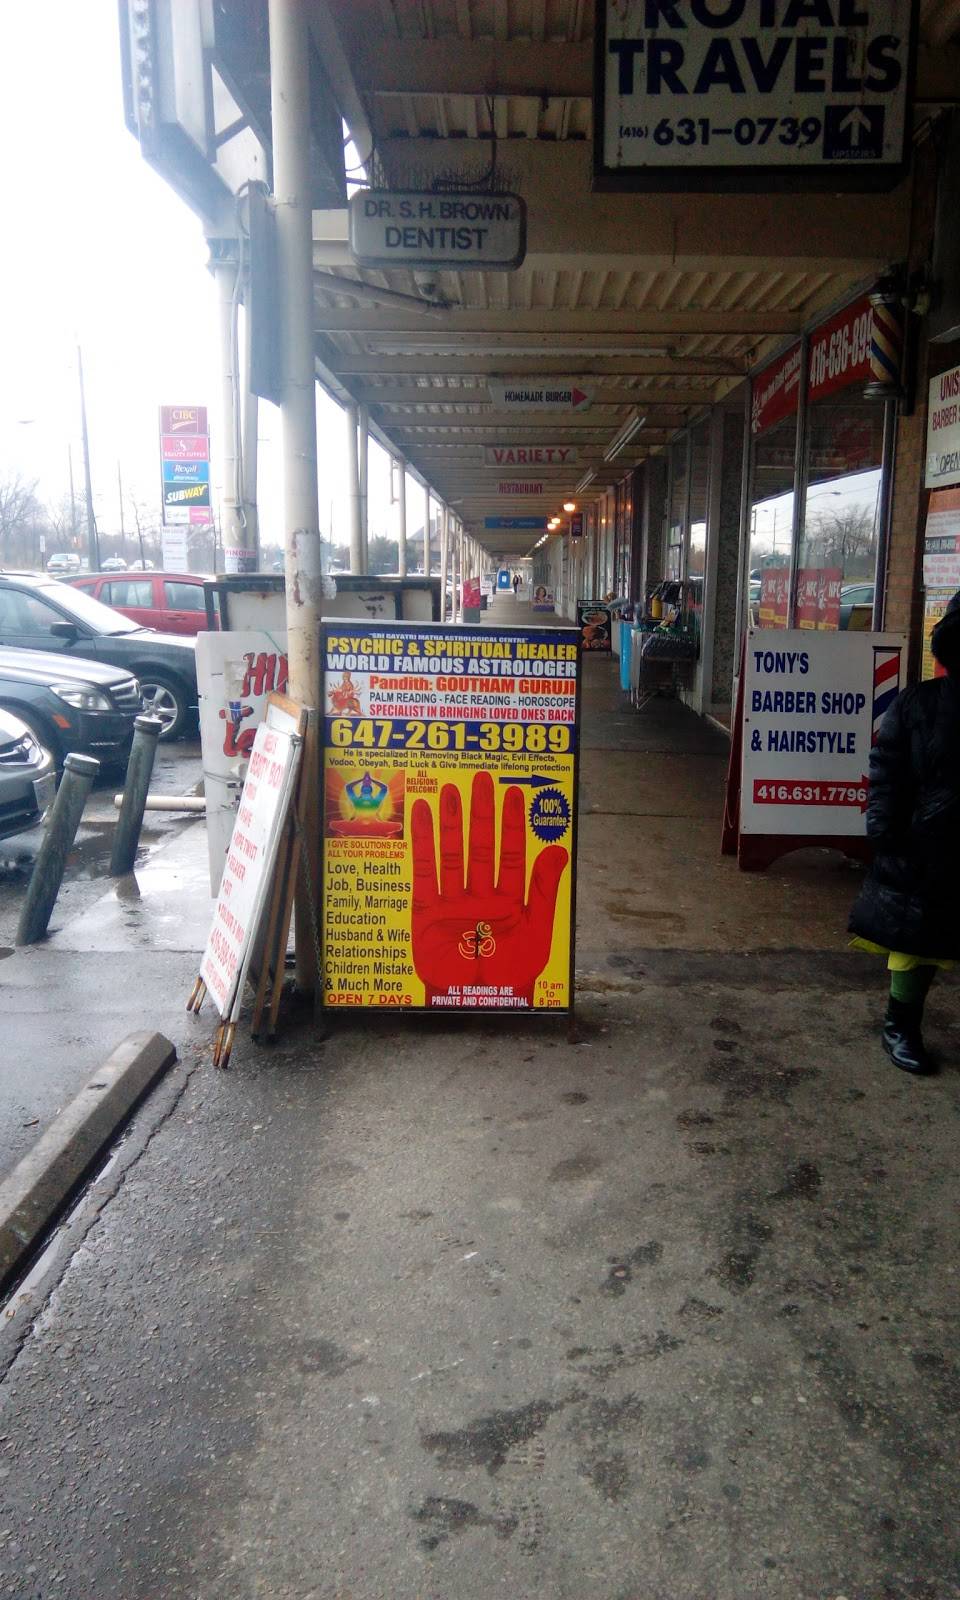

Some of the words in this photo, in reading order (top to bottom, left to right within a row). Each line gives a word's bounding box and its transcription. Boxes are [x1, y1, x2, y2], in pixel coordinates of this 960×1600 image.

[608, 35, 901, 95] TRAVELS
[618, 125, 648, 139] (416)
[653, 117, 822, 146] 631-0739
[364, 201, 395, 218] DR.
[440, 202, 509, 219] BROWN
[385, 227, 488, 249] DENTIST
[940, 370, 960, 401] UNIS
[504, 391, 543, 402] HOMEMADE
[545, 391, 572, 402] BURGER
[172, 410, 195, 420] CIBC
[932, 404, 957, 431] BARBER
[493, 449, 570, 463] VARIETY
[174, 464, 197, 474] Rexall
[165, 484, 207, 503] SUBWAY
[444, 635, 497, 643] ASTROLOGICAL
[327, 637, 403, 654] PSYCHIC
[407, 641, 420, 656] &
[424, 640, 512, 659] SPIRITUAL
[516, 643, 577, 660] HEALER
[327, 654, 389, 671] WORLD
[394, 656, 464, 673] FAMOUS
[467, 658, 577, 677] ASTROLOGER
[754, 652, 809, 674] TONY'S
[369, 675, 432, 691] Pandith:
[436, 676, 515, 693] GOUTHAM
[519, 679, 575, 695] GURUJI
[369, 692, 394, 702] PALM
[396, 692, 437, 703] READING
[445, 694, 467, 705] FACE
[471, 695, 510, 706] READING
[518, 696, 575, 707] HOROSCOPE
[752, 690, 816, 713] BARBER
[821, 692, 865, 715] SHOP
[369, 704, 424, 717] SPECIALIST
[427, 705, 437, 717] IN
[440, 705, 486, 719] BRINGING
[489, 707, 518, 720] LOVED
[521, 708, 544, 720] ONES
[548, 709, 575, 722] BACK
[331, 719, 570, 752] 647-261-3989
[751, 729, 762, 751] &
[768, 730, 856, 753] HAIRSTYLE
[343, 749, 354, 757] He
[356, 749, 362, 757] is
[365, 750, 408, 758] specialized
[410, 750, 417, 758] in
[420, 751, 458, 761] Removing
[461, 752, 482, 760] Black
[512, 753, 526, 761] Evil
[393, 760, 408, 768] Bad
[410, 760, 429, 768] Luck
[439, 761, 457, 769] Give
[500, 762, 529, 772] lifelong
[531, 764, 570, 772] protection
[757, 785, 867, 802] 416.631.7796
[539, 798, 562, 814] 100%
[533, 814, 567, 826] Guarantee
[350, 841, 391, 849] SOLUTIONS
[393, 841, 408, 849] FOR
[343, 850, 362, 858] YOUR
[365, 850, 405, 859] PROBLEMS
[327, 862, 359, 875] Love,
[363, 862, 401, 875] Health
[326, 878, 352, 892] Job,
[356, 879, 411, 892] Business
[326, 895, 362, 911] Family,
[364, 896, 408, 912] Marriage
[326, 911, 386, 925] Education
[326, 928, 373, 942] Husband
[376, 929, 384, 942] &
[387, 929, 410, 942] Wife
[326, 945, 407, 961] Relationships
[325, 961, 370, 975] Children
[373, 962, 414, 976] Mistake
[325, 978, 334, 991] &
[338, 978, 370, 991] Much
[373, 979, 403, 991] More
[448, 986, 461, 995] ALL
[462, 986, 498, 995] READINGS
[499, 987, 513, 996] ARE
[538, 981, 548, 989] 10
[327, 993, 363, 1003] OPEN
[368, 994, 375, 1004] 7
[379, 994, 412, 1004] DAYS
[431, 996, 461, 1005] PRIVATE
[462, 996, 478, 1006] AND
[478, 997, 528, 1006] CONFIDENTIAL
[546, 990, 554, 998] to
[539, 998, 544, 1006] 8
[548, 999, 560, 1007] pm
